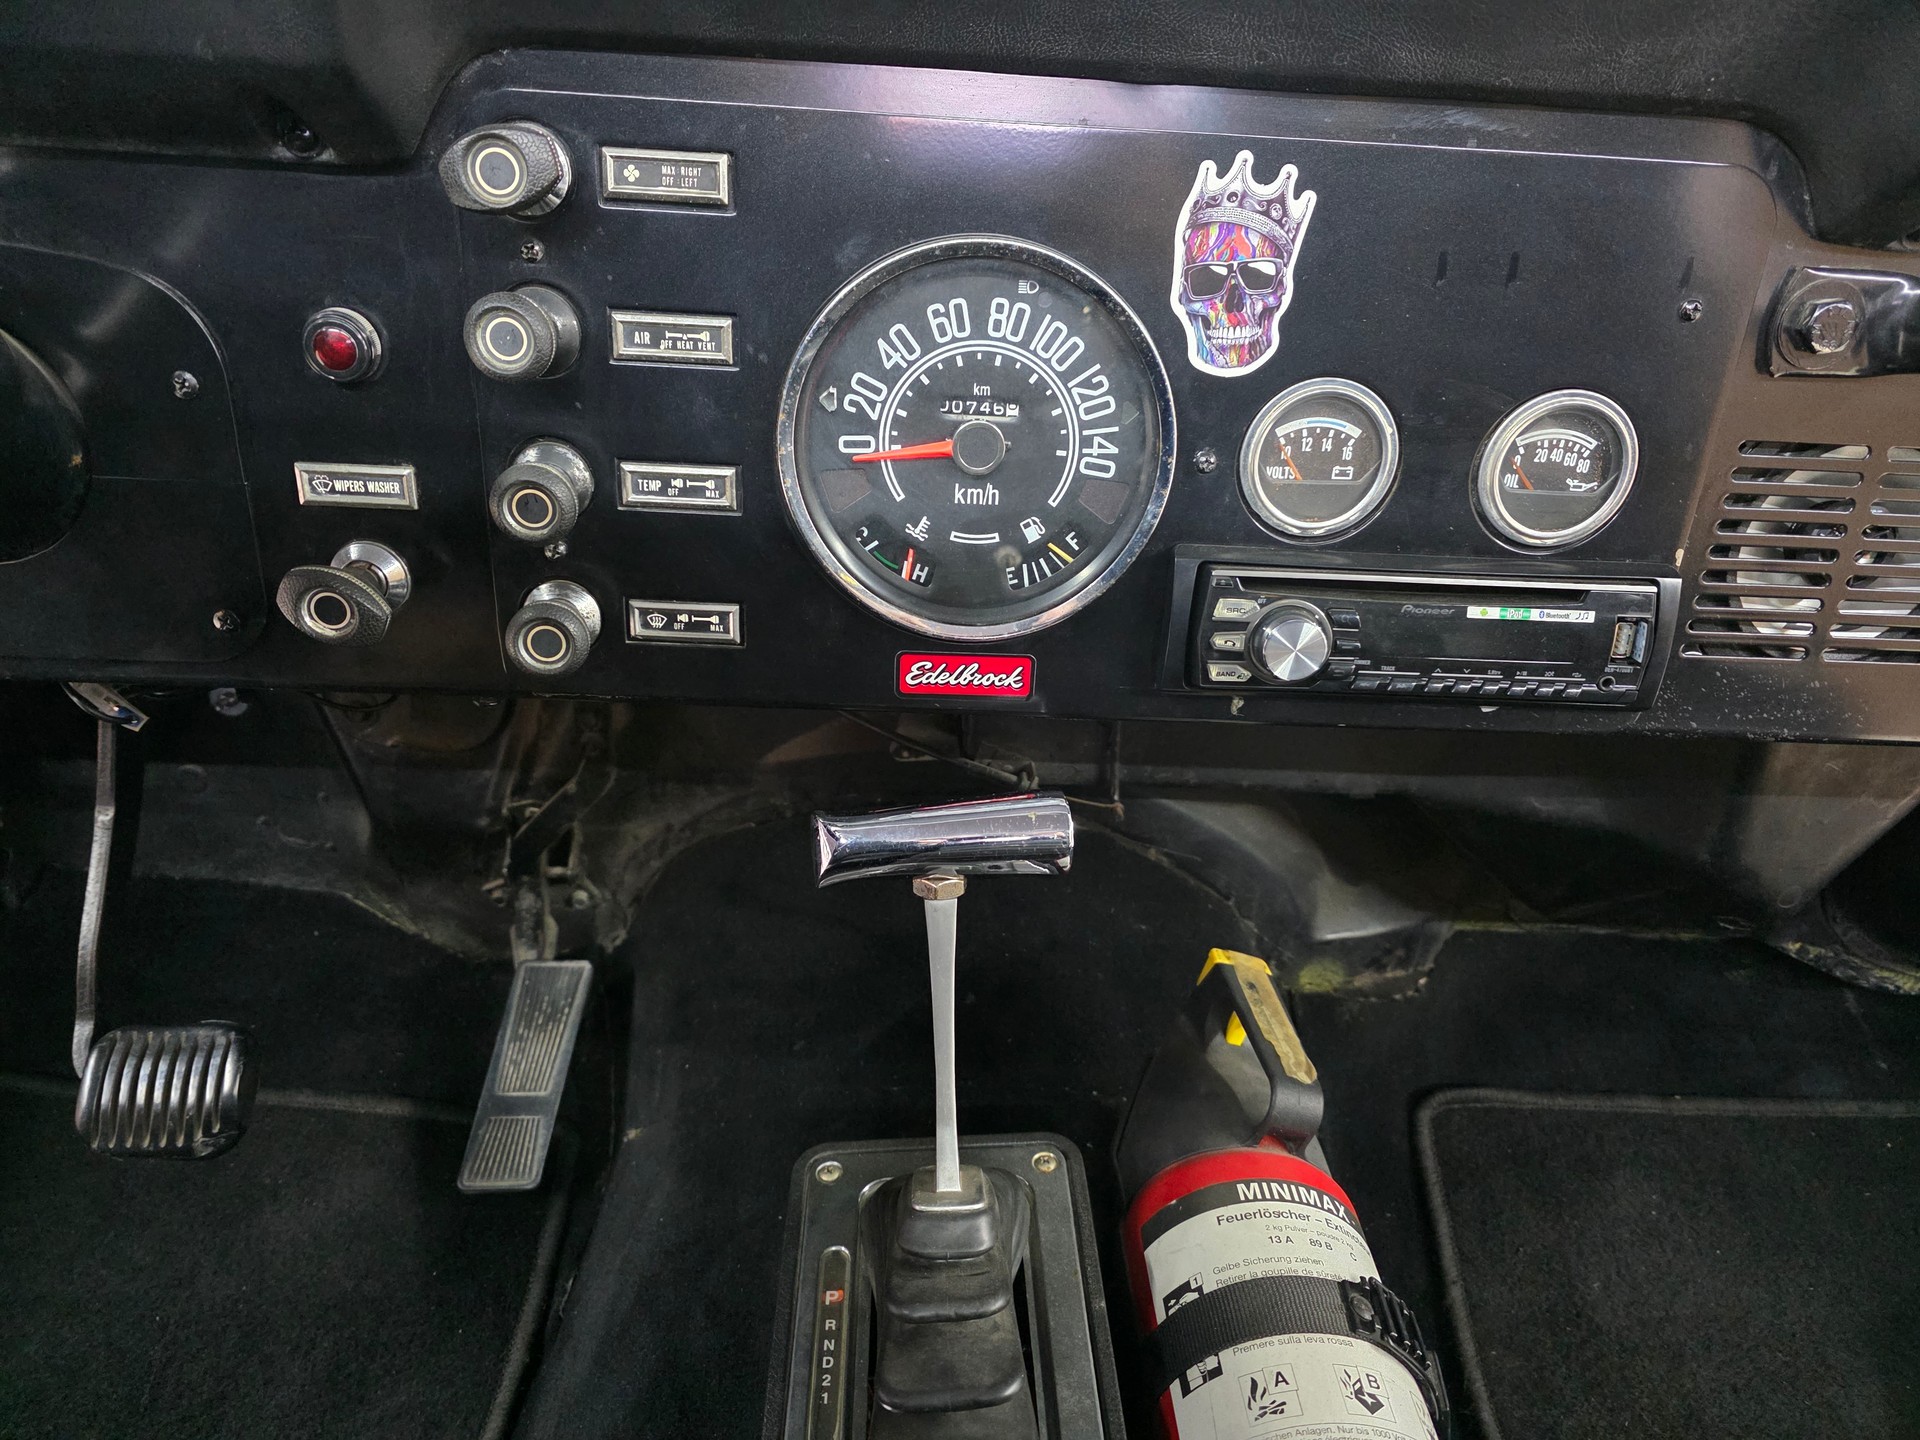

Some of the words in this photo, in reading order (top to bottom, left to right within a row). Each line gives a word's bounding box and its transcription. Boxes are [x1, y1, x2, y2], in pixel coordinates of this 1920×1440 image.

[680, 166, 702, 177] RIGHT
[662, 177, 674, 186] OFF
[681, 178, 698, 187] LEFT
[927, 298, 971, 344] 60
[987, 297, 1031, 342] 80
[634, 331, 650, 345] AIR
[660, 339, 673, 350] OFF
[677, 341, 694, 350] HEAT
[698, 342, 716, 351] VENT
[1029, 313, 1085, 372] 100
[877, 323, 921, 370] 40
[843, 372, 888, 421] 20
[973, 383, 991, 396] km
[1066, 363, 1116, 421] 120
[838, 435, 875, 453] 0
[1079, 426, 1120, 478] 140
[1301, 438, 1313, 452] 12
[1321, 438, 1333, 452] 14
[1341, 447, 1353, 461] 16
[1534, 448, 1548, 463] 20
[1549, 448, 1564, 463] 40
[1563, 452, 1578, 467] 60
[1576, 459, 1590, 474] 80
[1266, 466, 1296, 480] VOLTS
[1503, 473, 1519, 489] OIL
[333, 479, 365, 493] WIPERS
[366, 481, 401, 494] WASHER
[637, 479, 662, 492] TEMP
[668, 488, 679, 496] OFF
[705, 490, 720, 499] MAX
[953, 483, 1000, 506] km/h
[1065, 531, 1081, 551] F
[911, 563, 929, 583] H
[1006, 566, 1018, 585] E
[1226, 606, 1246, 614] SRC
[1401, 604, 1456, 616] Pioneer
[673, 622, 685, 630] OFF
[710, 624, 724, 632] MAX
[905, 661, 1024, 689] Edelbrock
[1236, 1182, 1352, 1224] MINIMAX
[1216, 1208, 1311, 1226] Feuerlöscher
[1272, 1224, 1283, 1233] kg
[1285, 1225, 1308, 1233] Pulver
[1268, 1236, 1282, 1244] 13
[1285, 1235, 1294, 1244] A
[1309, 1238, 1323, 1248] 89
[1325, 1241, 1333, 1251] B
[1212, 1261, 1241, 1275] Gelbe
[1242, 1256, 1292, 1267] Sicherung
[1294, 1255, 1325, 1266] ziehen
[1192, 1277, 1198, 1285] 1
[1215, 1272, 1247, 1288] Retirer
[1249, 1270, 1259, 1278] la
[1301, 1267, 1314, 1275] de
[825, 1290, 839, 1306] P
[825, 1319, 837, 1331] R
[823, 1339, 835, 1351] N
[1232, 1340, 1275, 1357] Premere
[1277, 1336, 1301, 1346] sulla
[1303, 1335, 1325, 1344] leva
[1327, 1337, 1354, 1348] rossa
[822, 1356, 834, 1369] D
[822, 1374, 832, 1387] 2
[1274, 1371, 1290, 1388] A
[1366, 1373, 1380, 1390] B
[821, 1392, 829, 1405] 1
[1295, 1427, 1336, 1437] Anlagen.
[1337, 1425, 1355, 1434] Nur
[1356, 1427, 1370, 1436] bis
[1371, 1429, 1392, 1440] 1000
